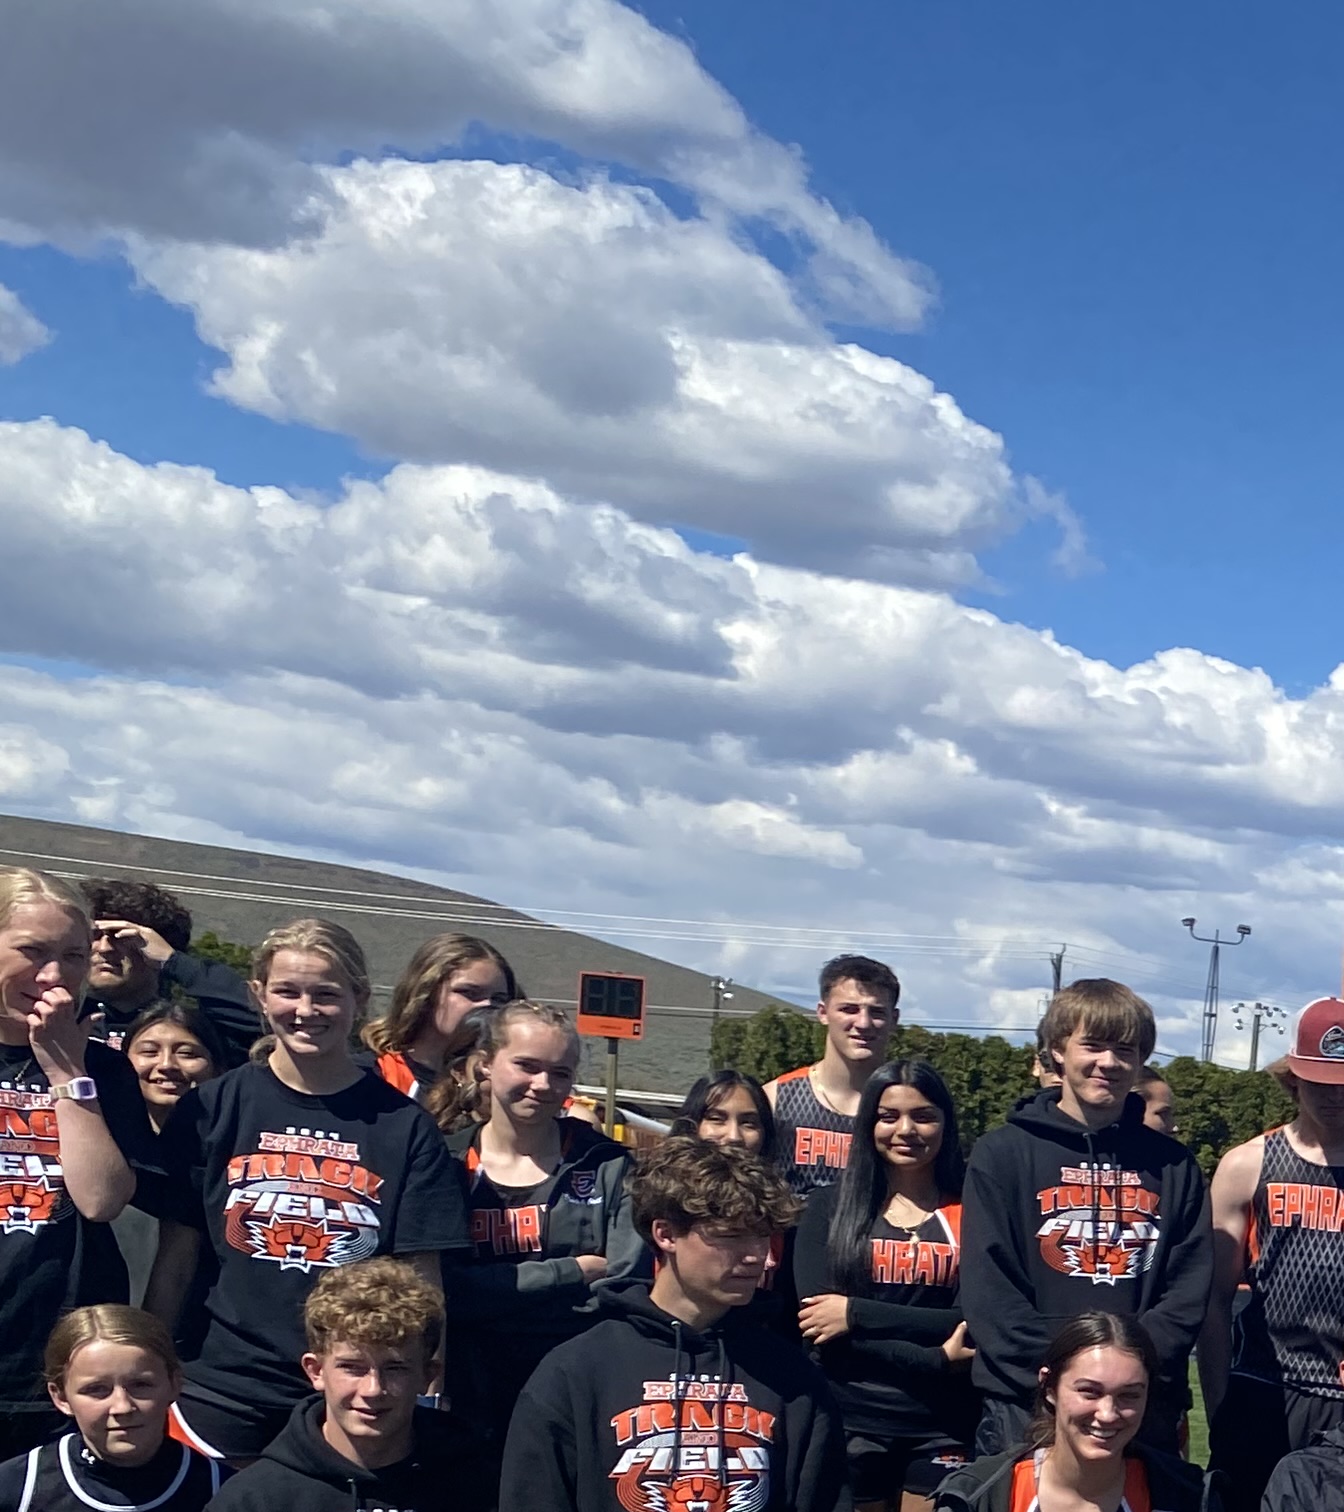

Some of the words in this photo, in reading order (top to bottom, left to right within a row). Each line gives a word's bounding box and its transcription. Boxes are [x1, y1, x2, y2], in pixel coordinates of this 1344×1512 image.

[258, 1132, 360, 1161] EPHRATA
[226, 1154, 385, 1205] TRACK
[223, 1188, 380, 1228] FIELD
[611, 1401, 776, 1446] TRACK
[609, 1447, 770, 1477] FIELD
